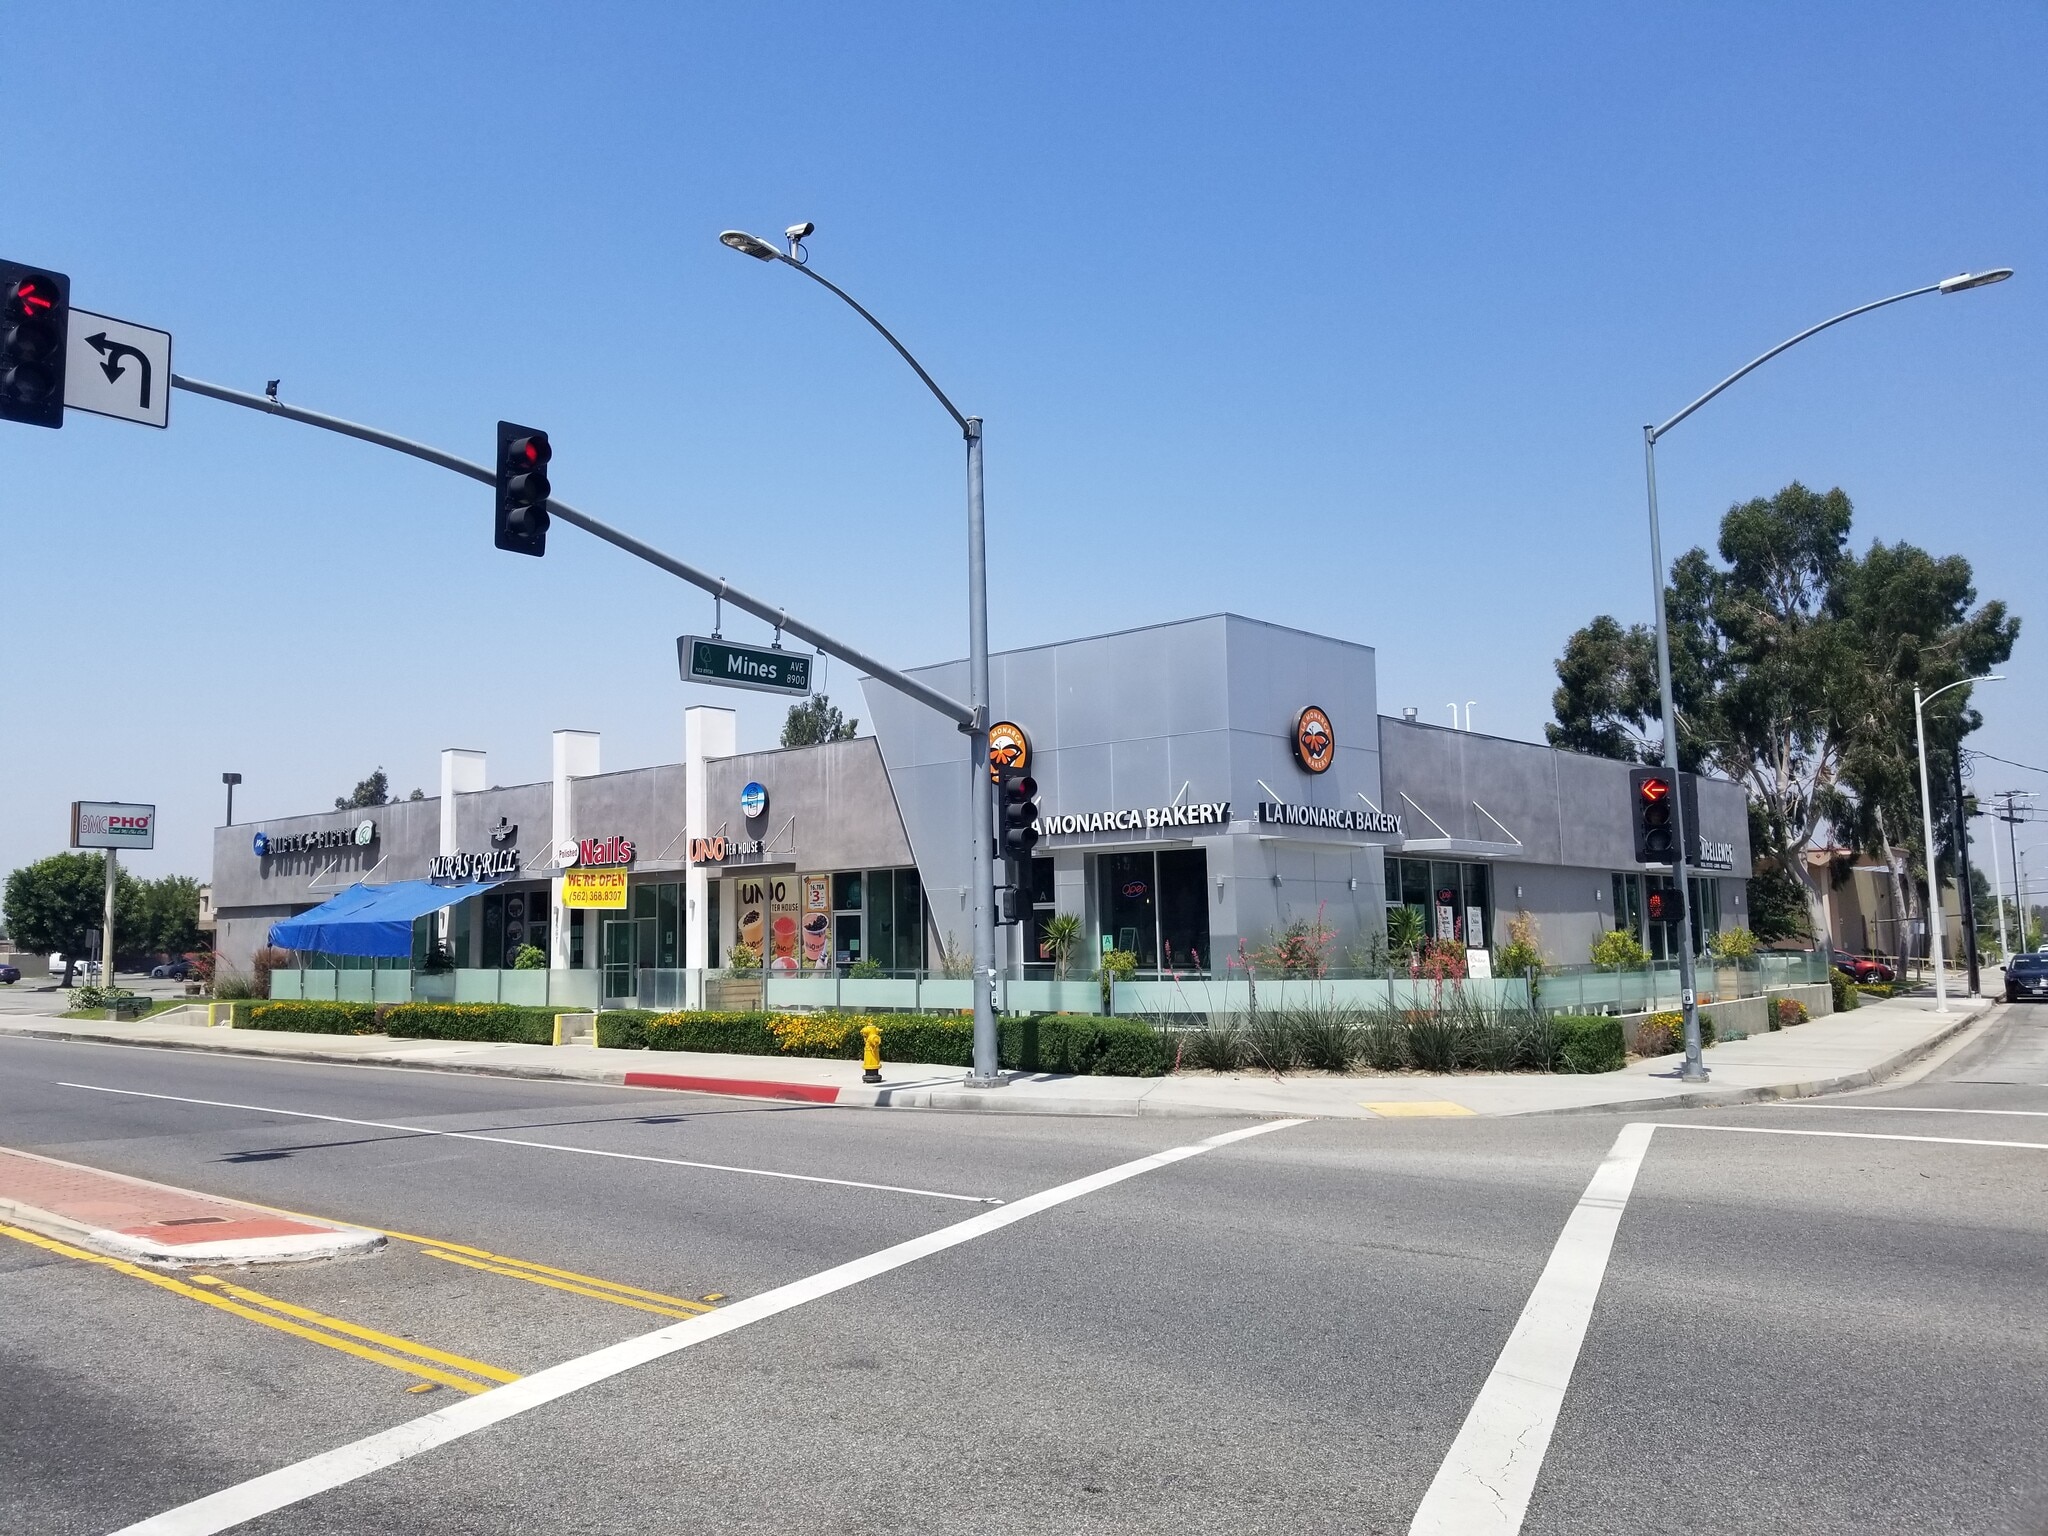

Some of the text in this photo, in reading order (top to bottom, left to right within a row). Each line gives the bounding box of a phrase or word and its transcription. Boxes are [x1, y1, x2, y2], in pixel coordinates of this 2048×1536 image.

[727, 654, 777, 679] Mines
[790, 661, 804, 673] AVE
[786, 673, 806, 686] 8900
[1305, 711, 1329, 734] MONARCA
[991, 726, 1022, 746] MONARCA
[1307, 756, 1328, 769] BAKERY
[81, 815, 107, 834] BMC
[1045, 809, 1143, 835] MONARCA
[1146, 802, 1227, 828] BAKERY
[1265, 802, 1402, 834] LA MONARCA BAKERY
[269, 834, 305, 855] NIFTY
[317, 828, 356, 849] FIFTY
[580, 835, 632, 866] Nails
[689, 836, 758, 862] UNO TEA HOUSE
[559, 848, 578, 859] Polished
[428, 849, 516, 882] MIRAS GRILL
[568, 873, 625, 887] WE'RE OPEN
[1123, 884, 1147, 896] Open
[569, 890, 622, 903] (562) 368.8307
[742, 881, 786, 905] UNO
[771, 903, 780, 912] TEA
[781, 903, 799, 912] HOUSE
